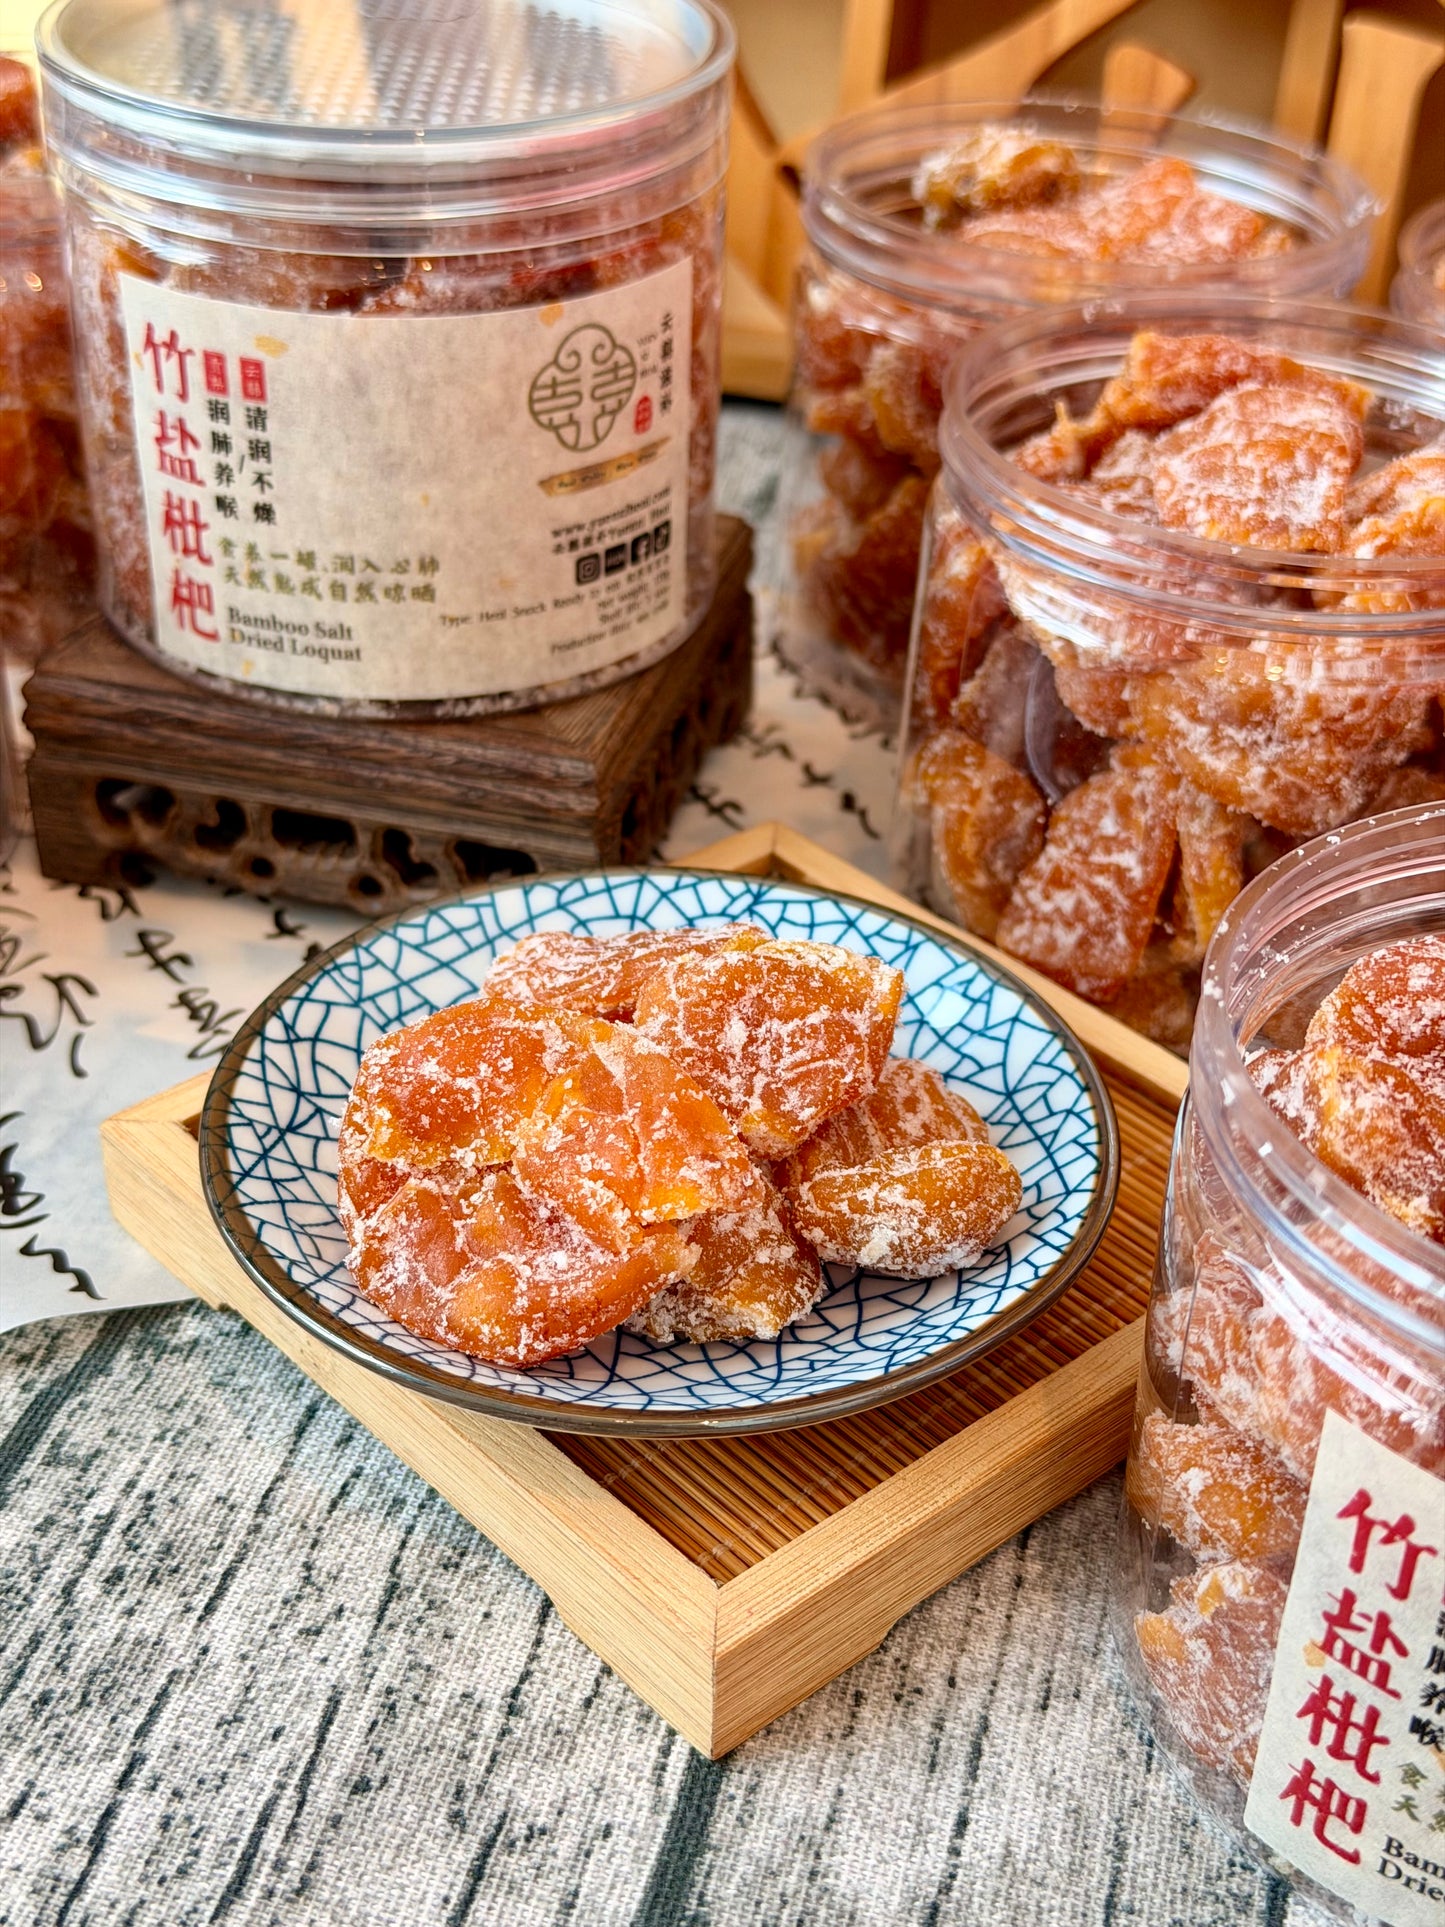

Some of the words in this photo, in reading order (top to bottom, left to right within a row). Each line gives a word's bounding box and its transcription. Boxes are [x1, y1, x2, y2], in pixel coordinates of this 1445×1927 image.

[144, 322, 220, 642] 竹盐枇杷
[207, 399, 239, 520] 润肺养喉
[245, 406, 276, 526] 清润不燥
[227, 605, 310, 637] Bamboo
[313, 620, 354, 642] Salt
[229, 626, 286, 654] Dried
[290, 639, 362, 664] Loquat
[1279, 1488, 1438, 1865] 竹盐枇杷
